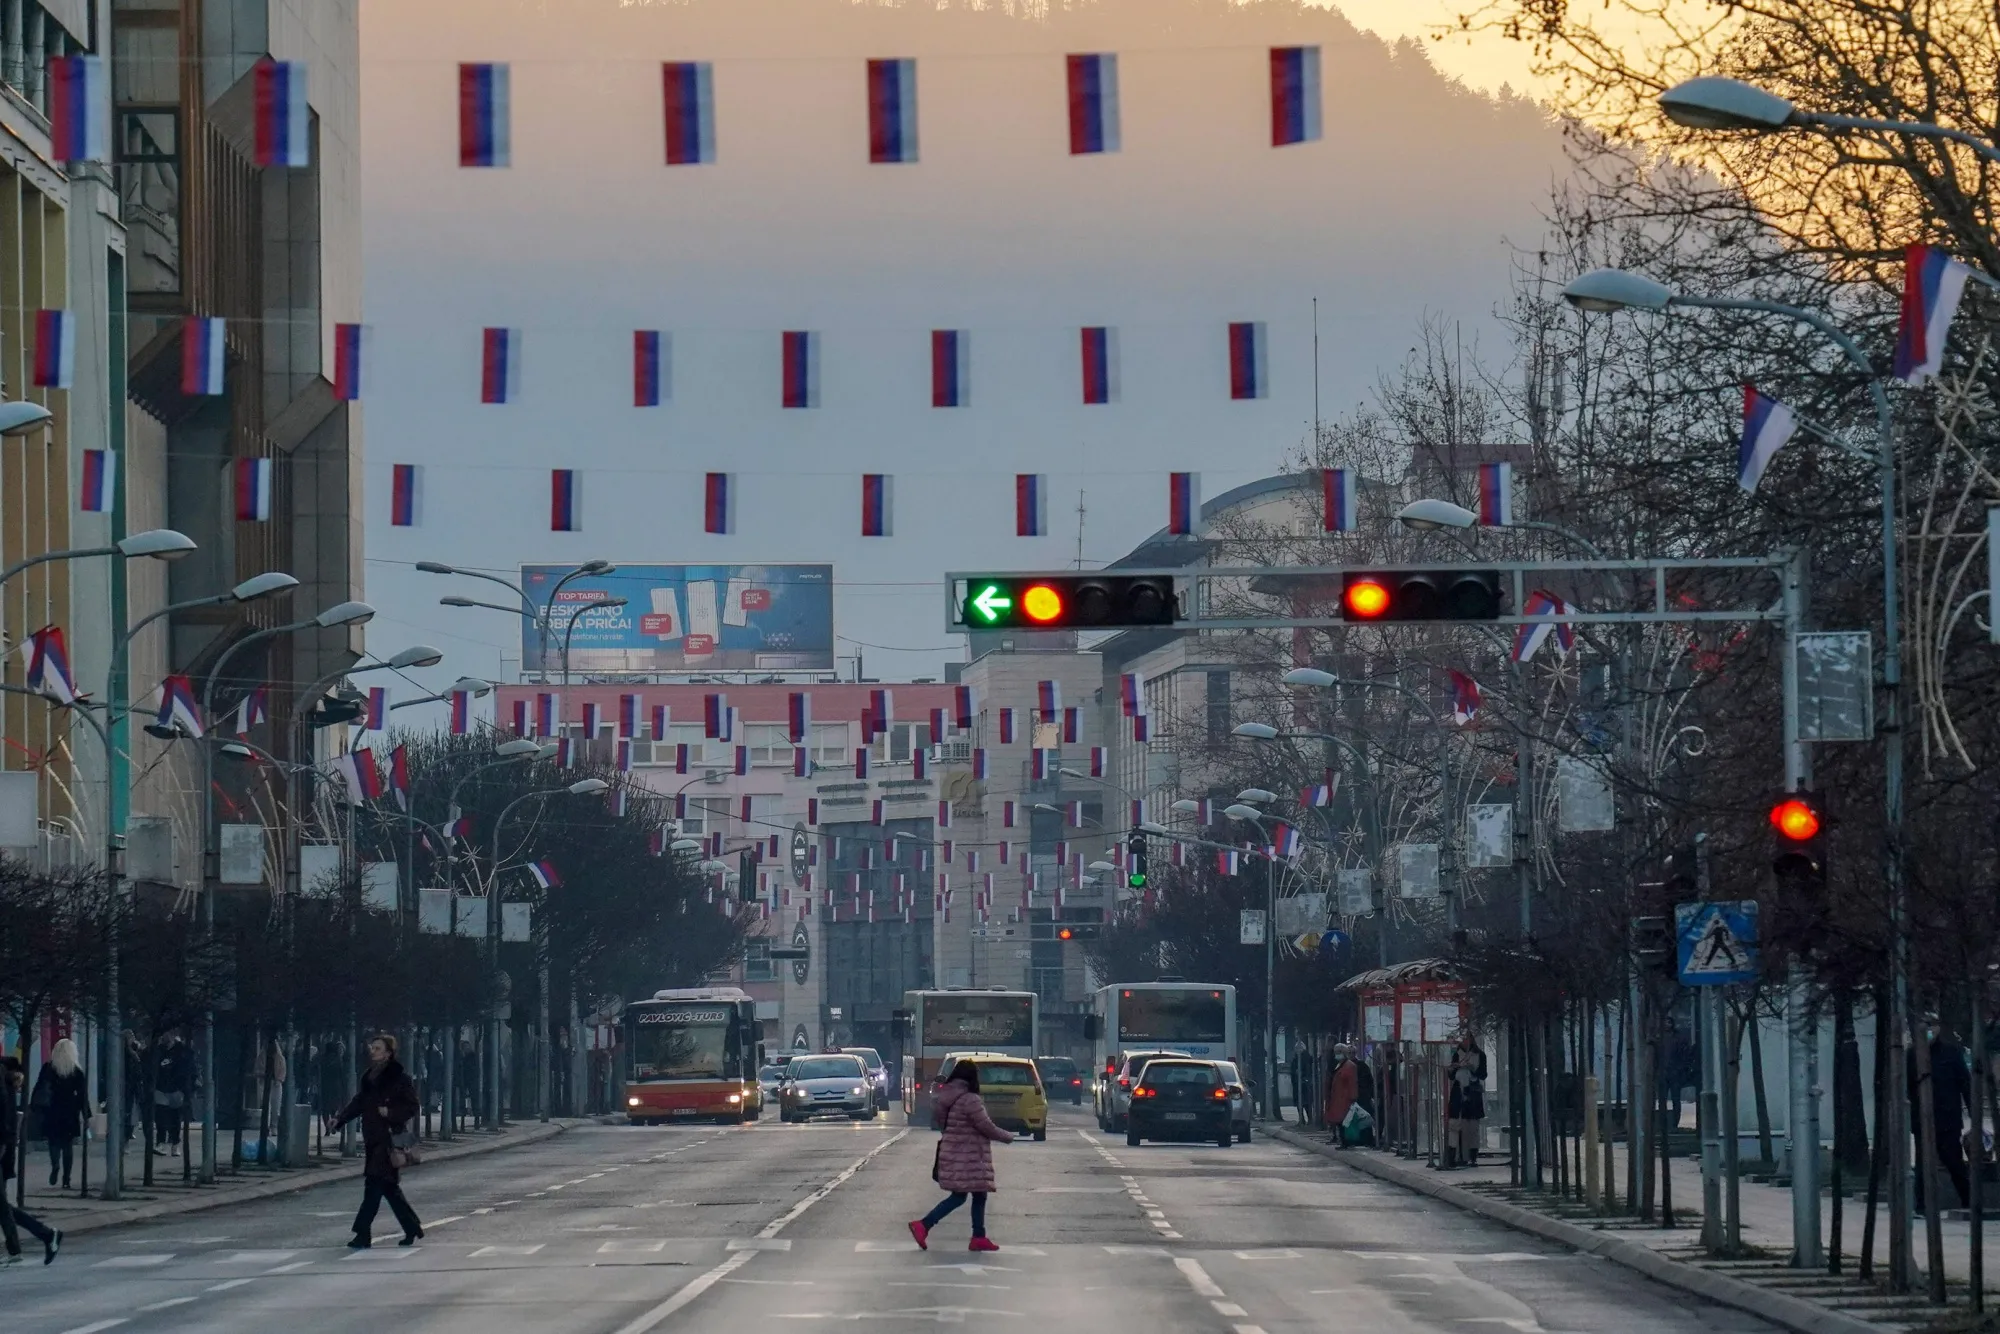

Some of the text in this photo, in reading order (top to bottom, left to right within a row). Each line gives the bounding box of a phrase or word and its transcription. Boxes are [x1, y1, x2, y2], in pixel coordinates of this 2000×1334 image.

[559, 592, 605, 600] TOP TARIFA
[585, 616, 632, 629] PRIČA!
